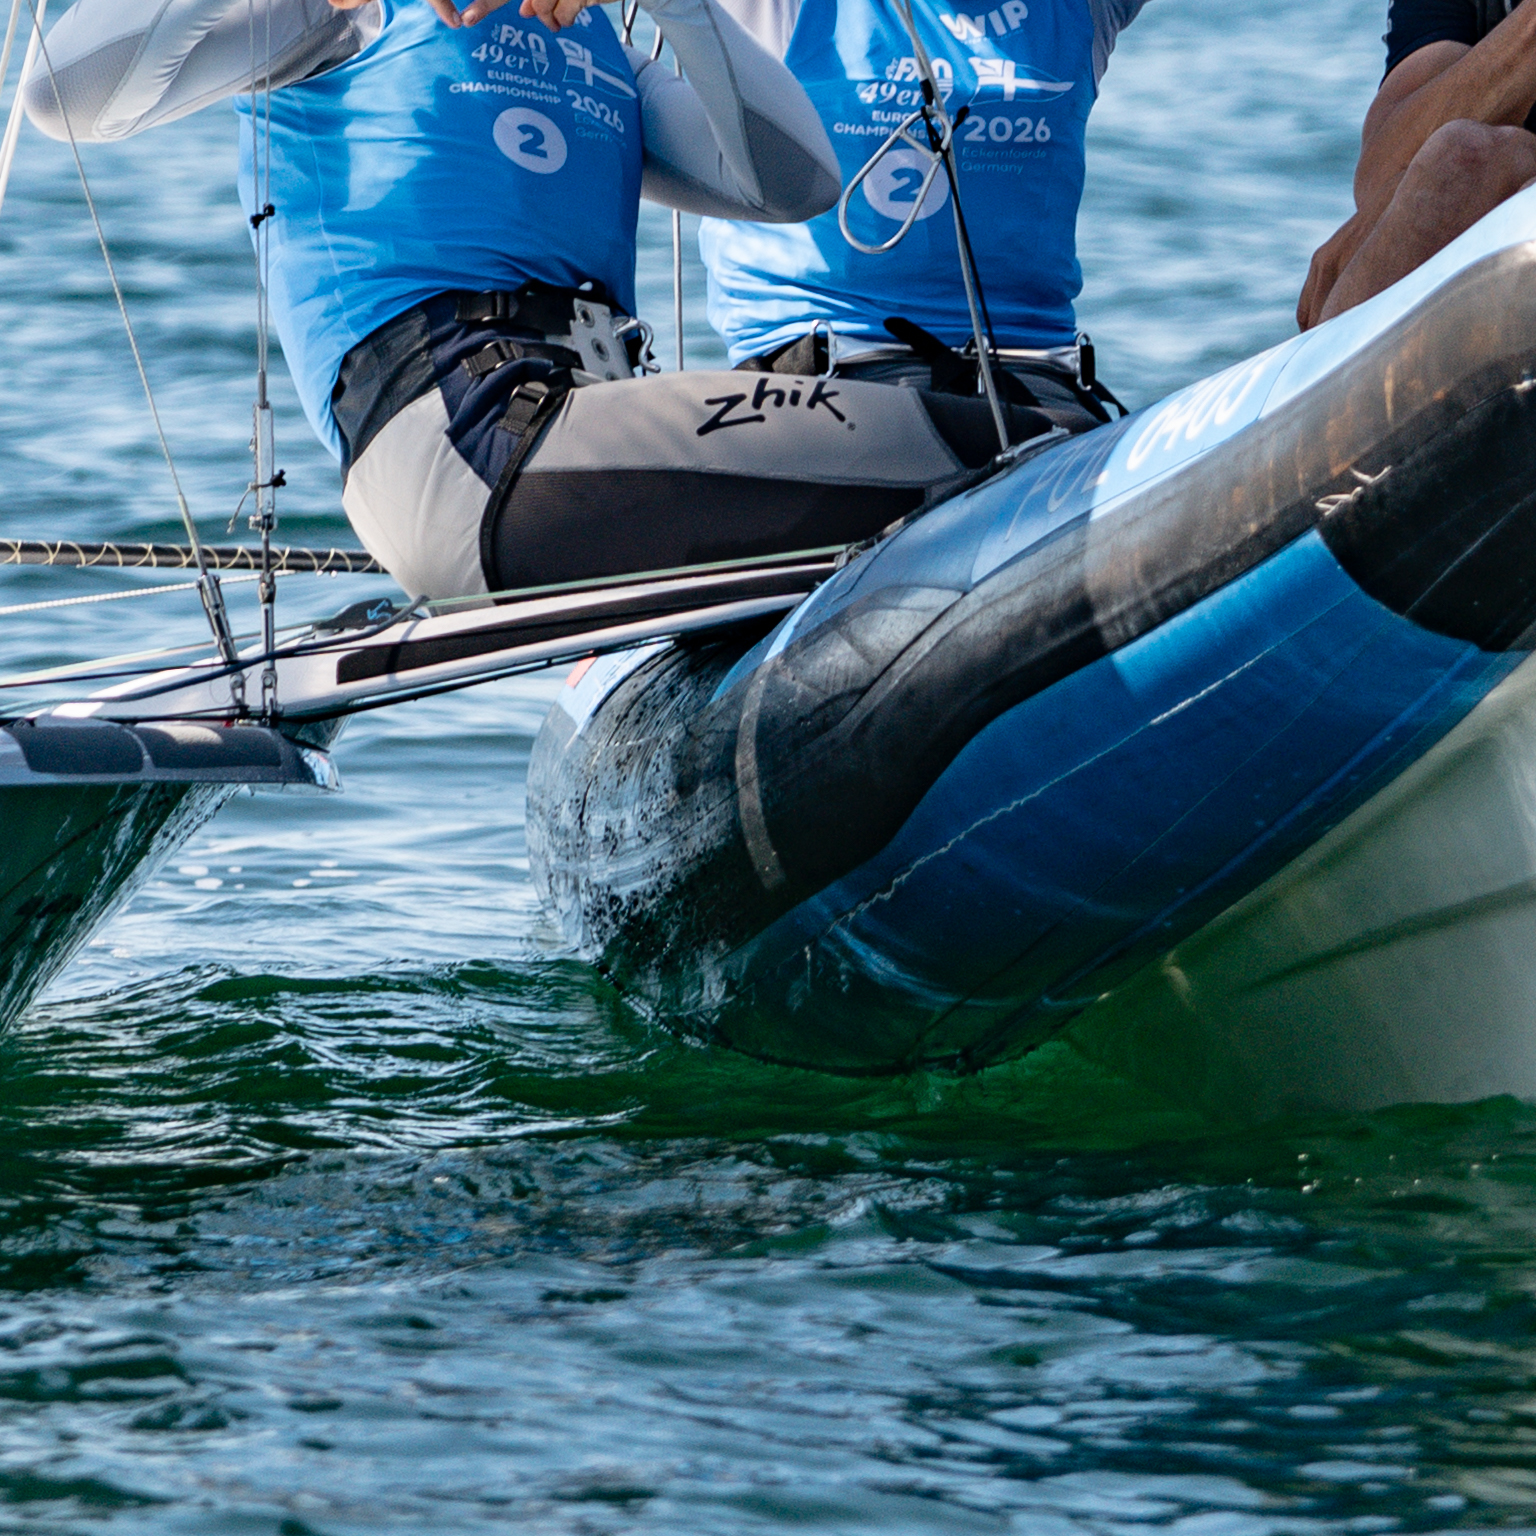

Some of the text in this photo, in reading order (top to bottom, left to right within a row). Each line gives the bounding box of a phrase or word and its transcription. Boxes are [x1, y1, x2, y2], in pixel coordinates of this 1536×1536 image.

[939, 0, 1029, 41] WIP
[499, 24, 526, 51] FX
[471, 43, 529, 70] 49er
[449, 81, 561, 104] CHAMPIONSHIP
[487, 70, 558, 93] EUROPEAN
[859, 81, 924, 106] 49er
[566, 89, 625, 133] 2026
[517, 123, 549, 159] 2
[964, 116, 1052, 142] 2026
[961, 161, 1025, 176] Germany
[888, 167, 925, 203] 2
